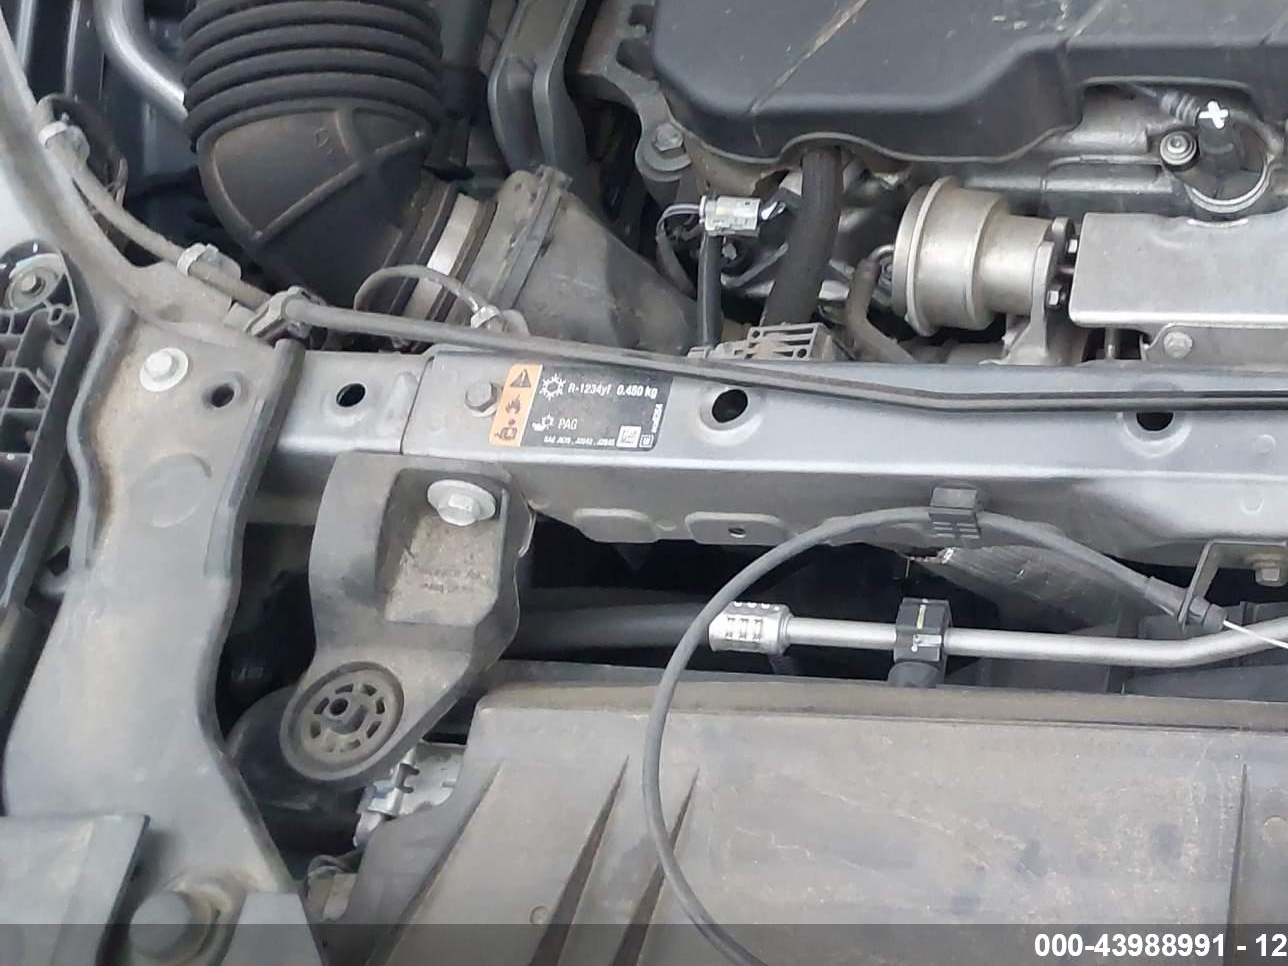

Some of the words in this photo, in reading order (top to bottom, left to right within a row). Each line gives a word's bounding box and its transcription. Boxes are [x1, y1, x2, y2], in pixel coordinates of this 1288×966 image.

[568, 383, 611, 397] R-1234yf
[644, 385, 658, 399] kg
[557, 418, 578, 430] PAG
